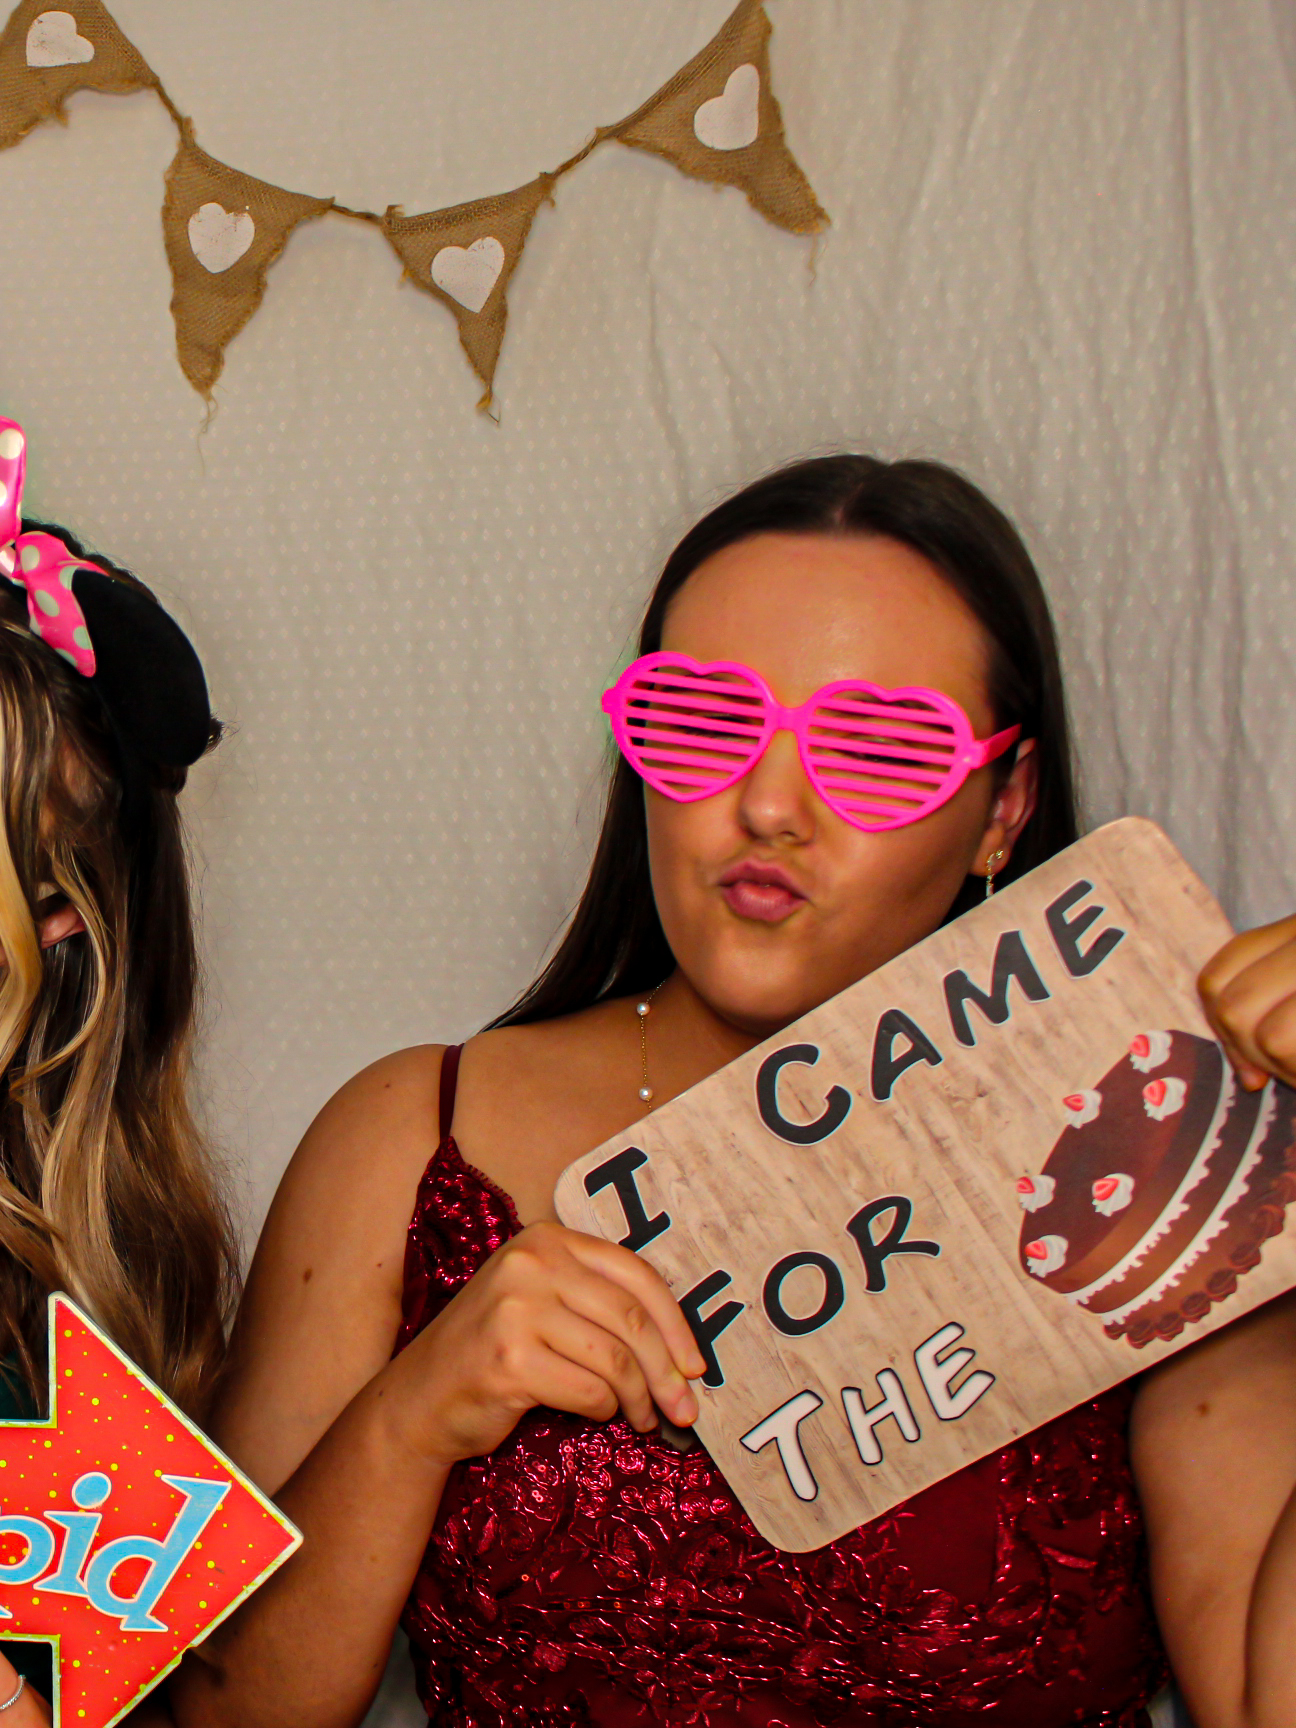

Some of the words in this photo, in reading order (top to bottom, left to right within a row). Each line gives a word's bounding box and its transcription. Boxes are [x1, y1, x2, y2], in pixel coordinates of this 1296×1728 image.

[583, 1145, 672, 1254] I
[755, 878, 1128, 1146] CAME
[676, 1194, 943, 1389] FOR
[739, 1321, 997, 1503] THE
